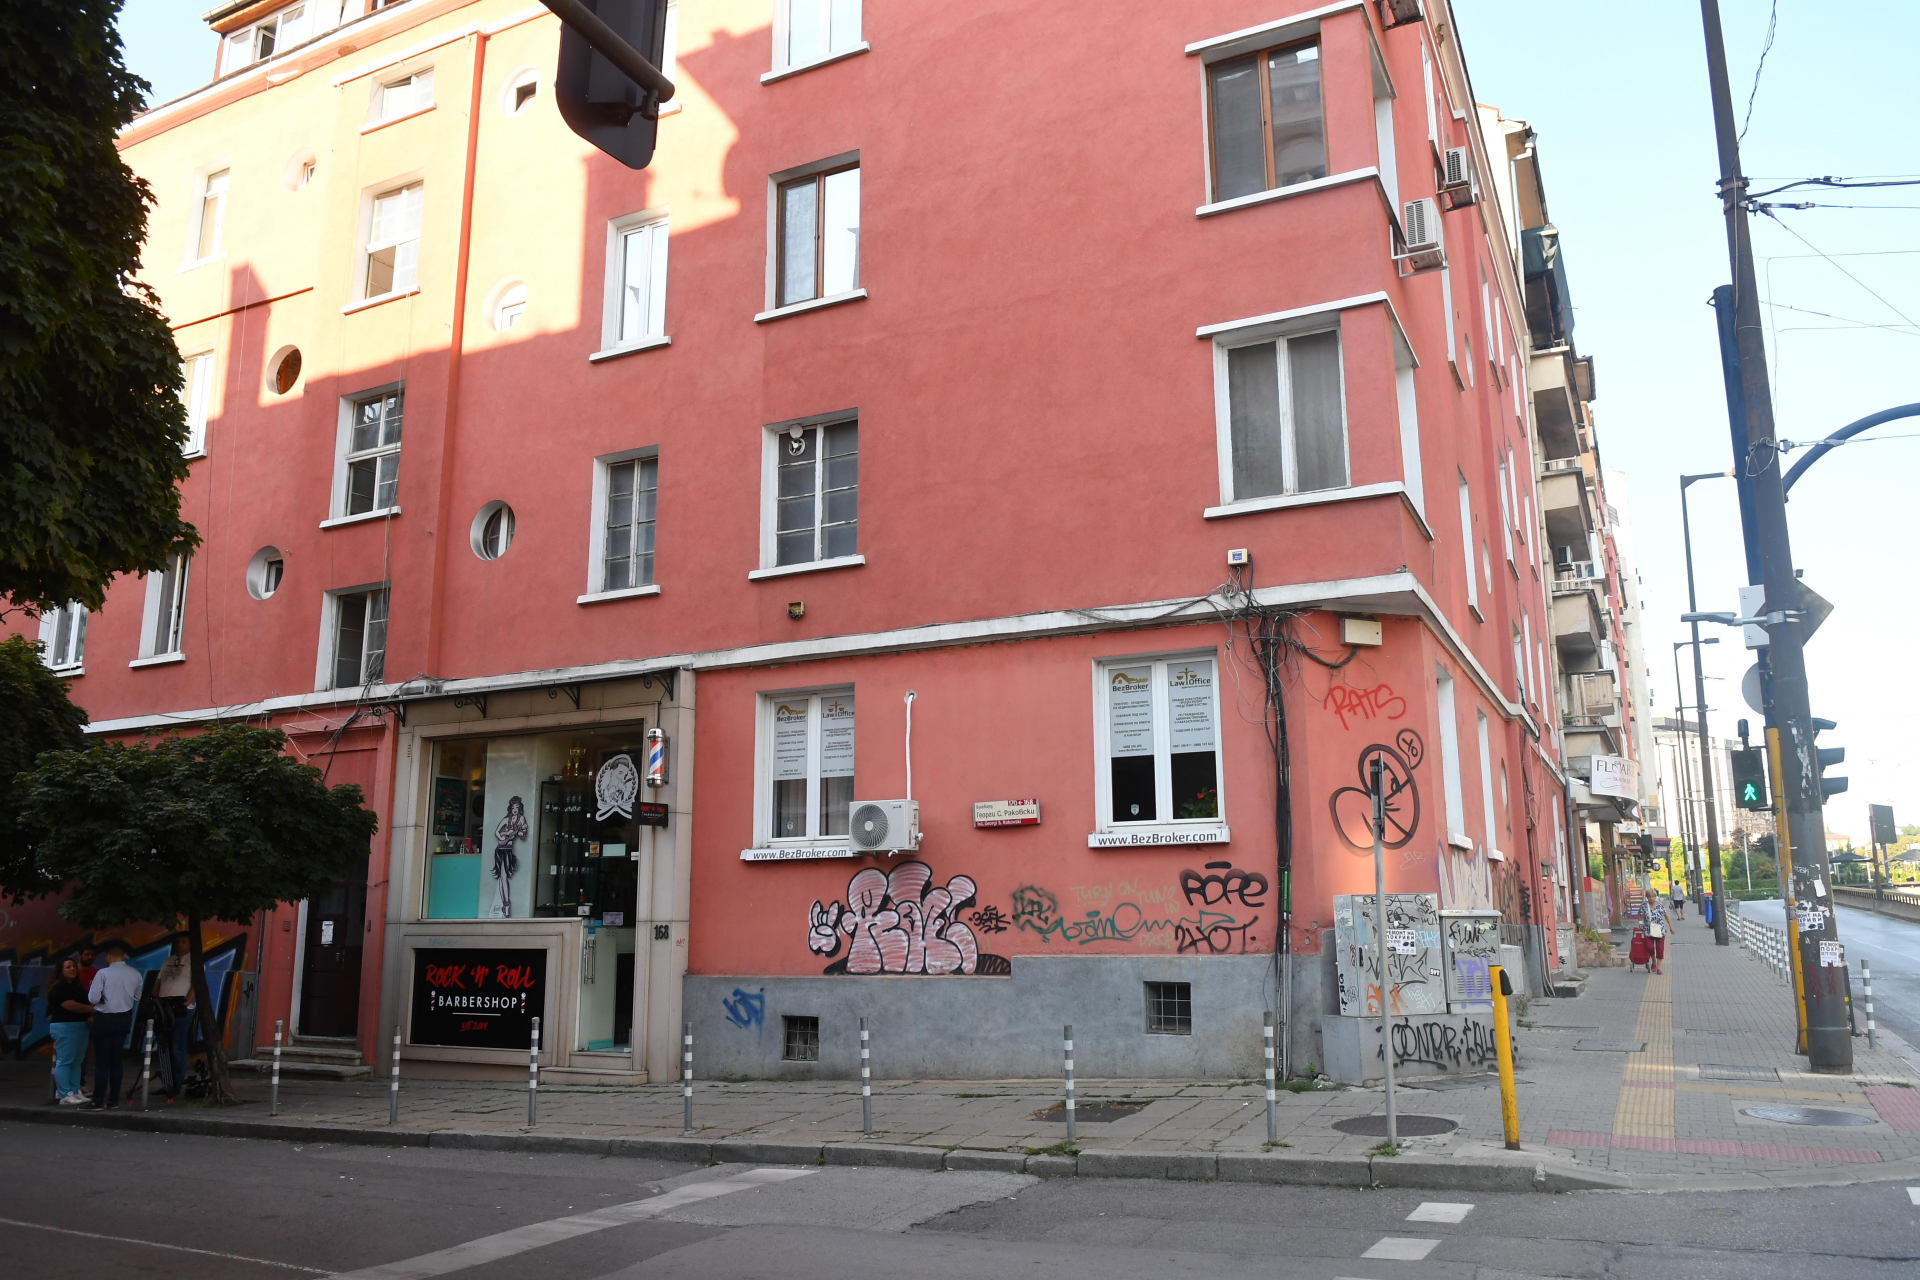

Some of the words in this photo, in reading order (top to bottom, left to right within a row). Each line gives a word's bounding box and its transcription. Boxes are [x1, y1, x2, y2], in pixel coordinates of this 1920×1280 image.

[1112, 684, 1148, 692] BezBroker
[1004, 808, 1034, 816] Раковски
[1098, 831, 1217, 846] www.BezBroker.com
[753, 848, 847, 860] www.BezBroker.com
[654, 924, 669, 940] 168
[426, 964, 466, 989] ROCK
[496, 964, 536, 989] ROLL
[438, 995, 517, 1008] BARBERSHOP
